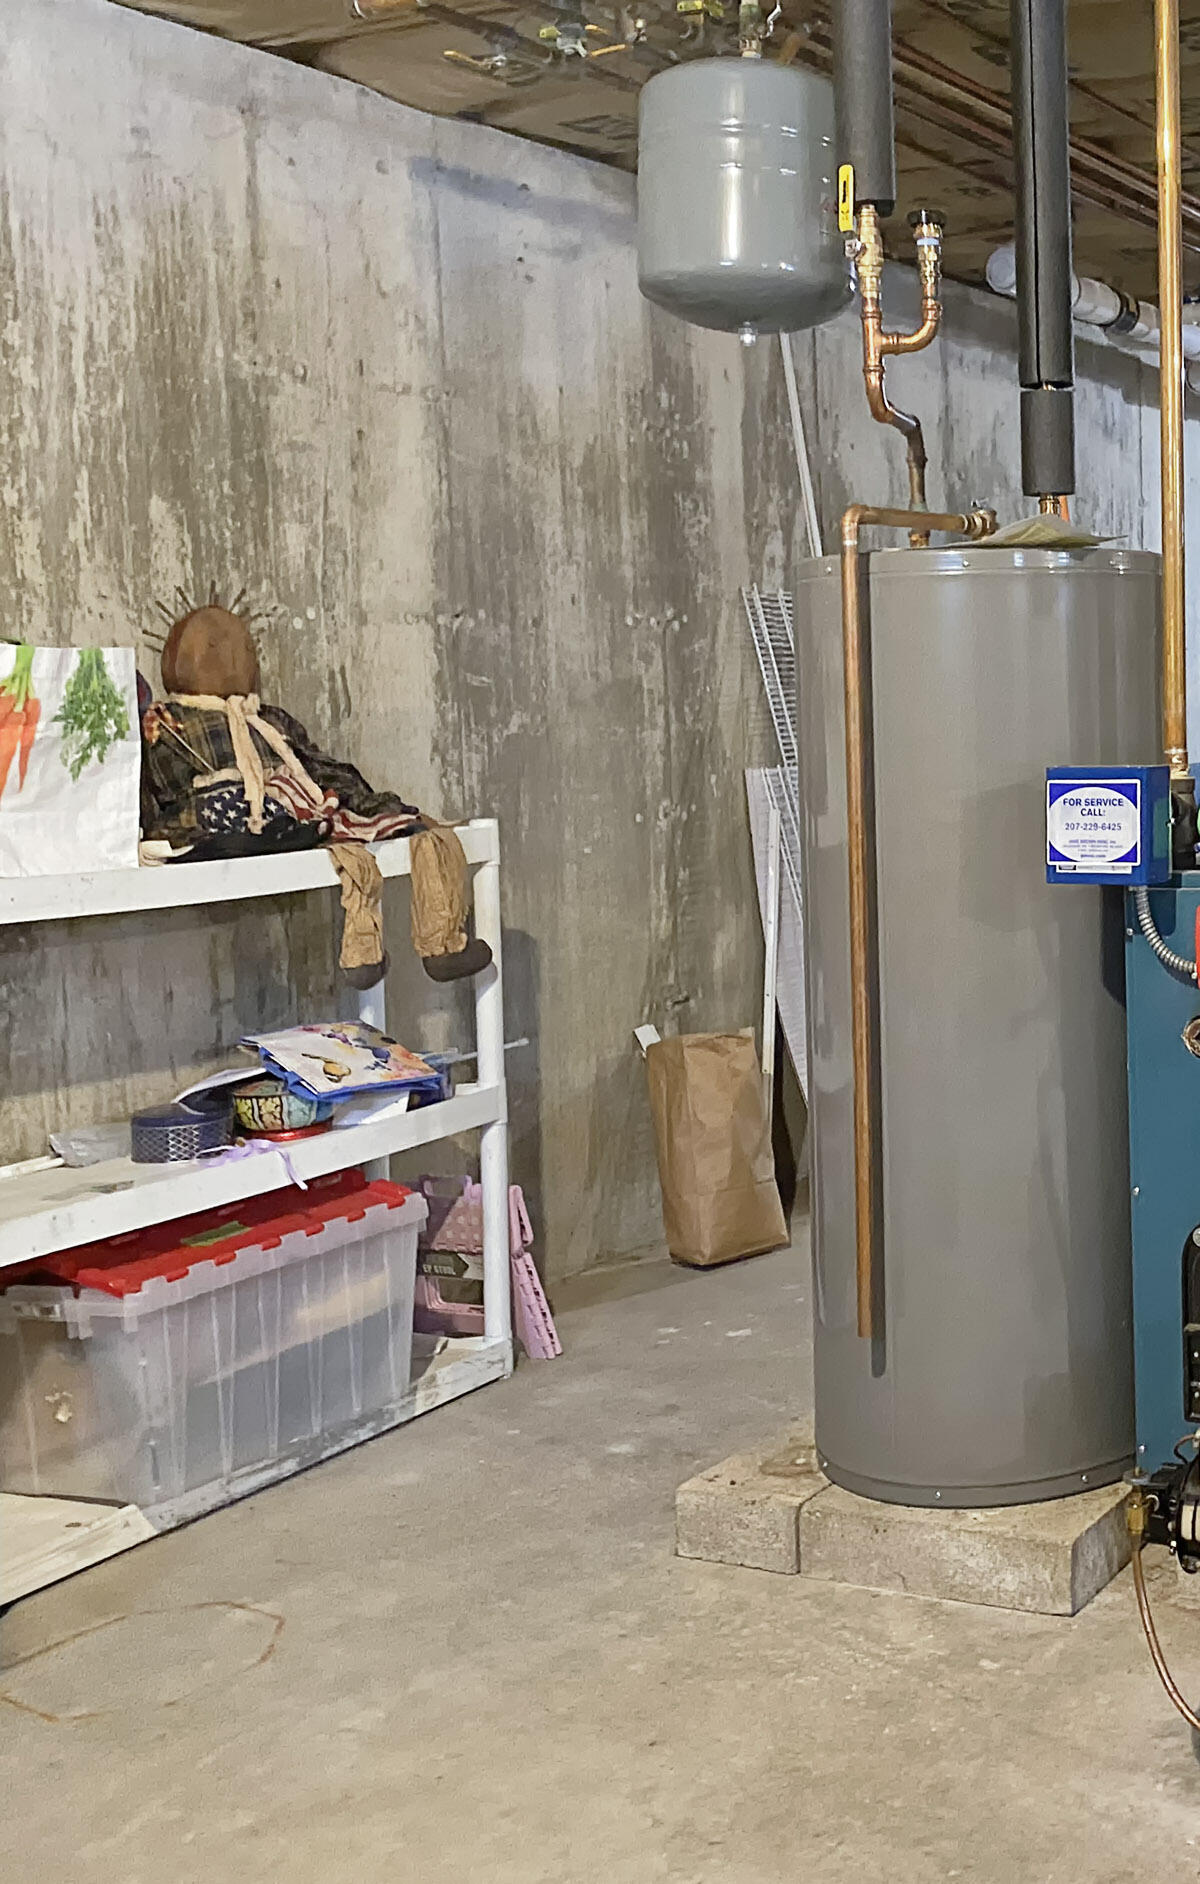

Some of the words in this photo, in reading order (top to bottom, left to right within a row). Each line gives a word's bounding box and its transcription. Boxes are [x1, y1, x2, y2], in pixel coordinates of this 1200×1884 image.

[1062, 798, 1082, 807] FOR
[1084, 798, 1124, 807] SERVICE
[1080, 808, 1106, 817] CALL:
